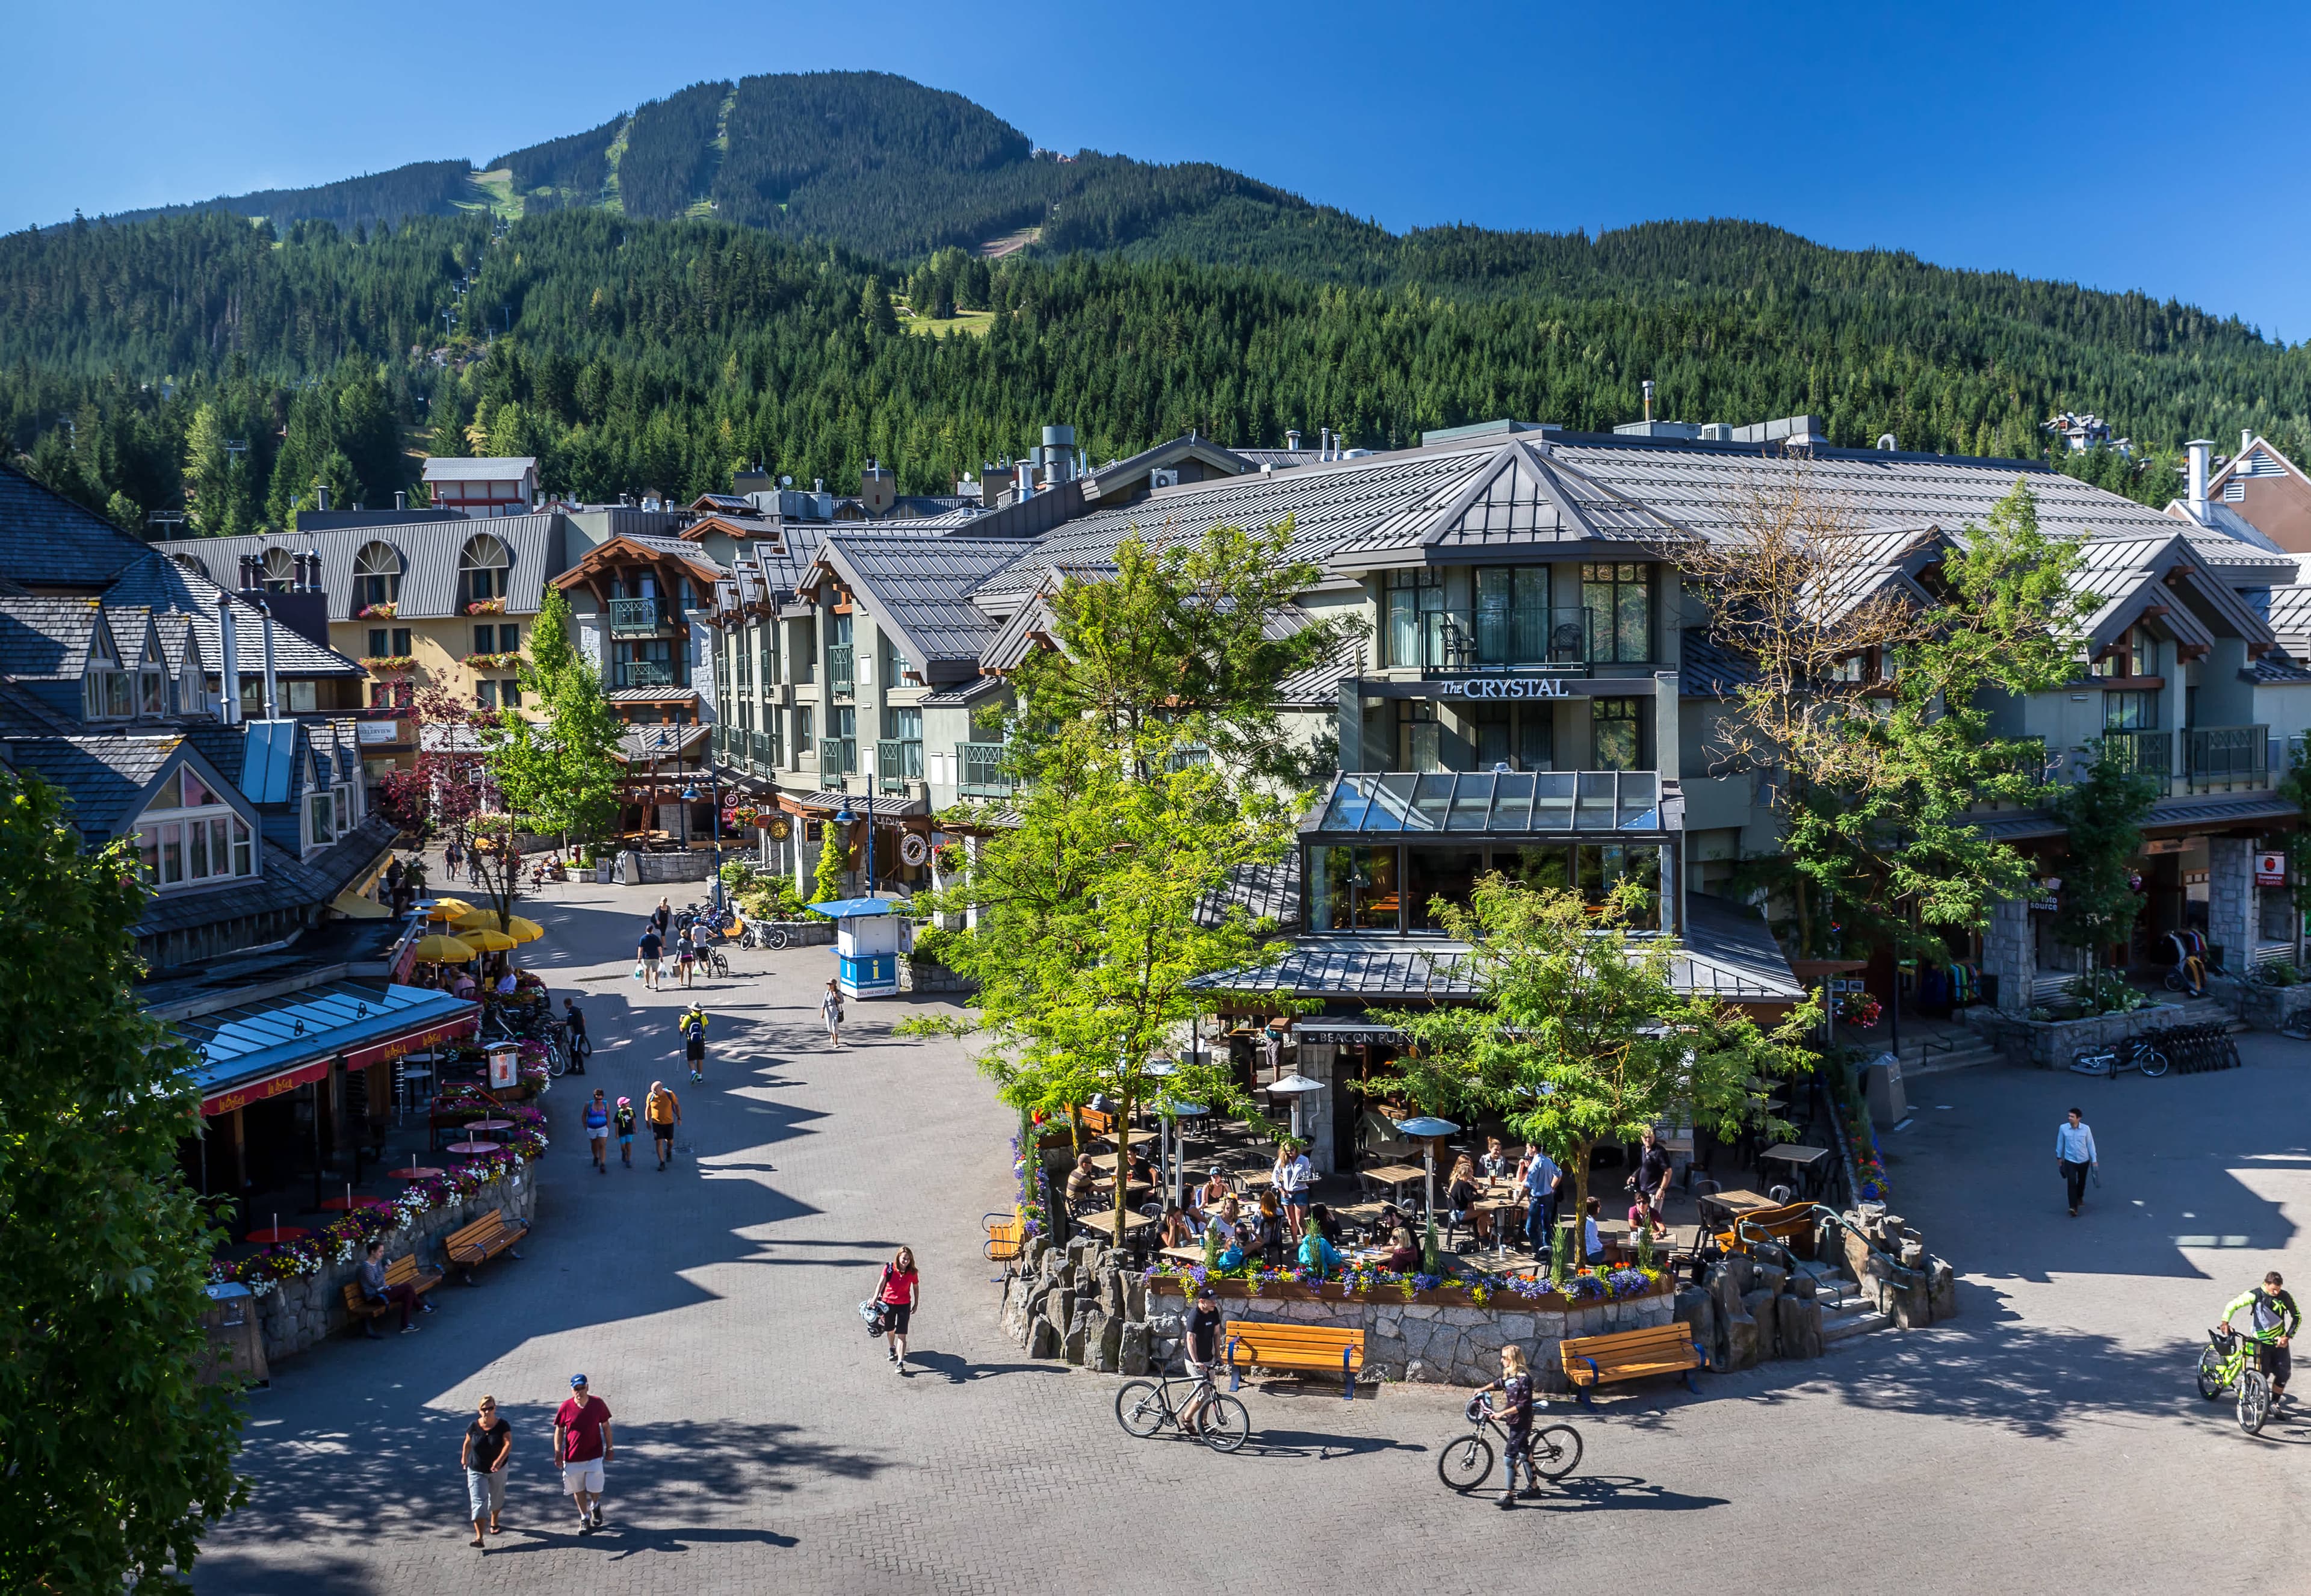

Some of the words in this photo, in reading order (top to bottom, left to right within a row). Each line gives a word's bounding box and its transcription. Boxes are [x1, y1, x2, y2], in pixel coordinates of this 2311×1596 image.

[1441, 681, 1462, 694] The
[1463, 678, 1569, 698] CRYSTAL
[1320, 1033, 1374, 1043] BEACON
[1378, 1032, 1404, 1043] PUB
